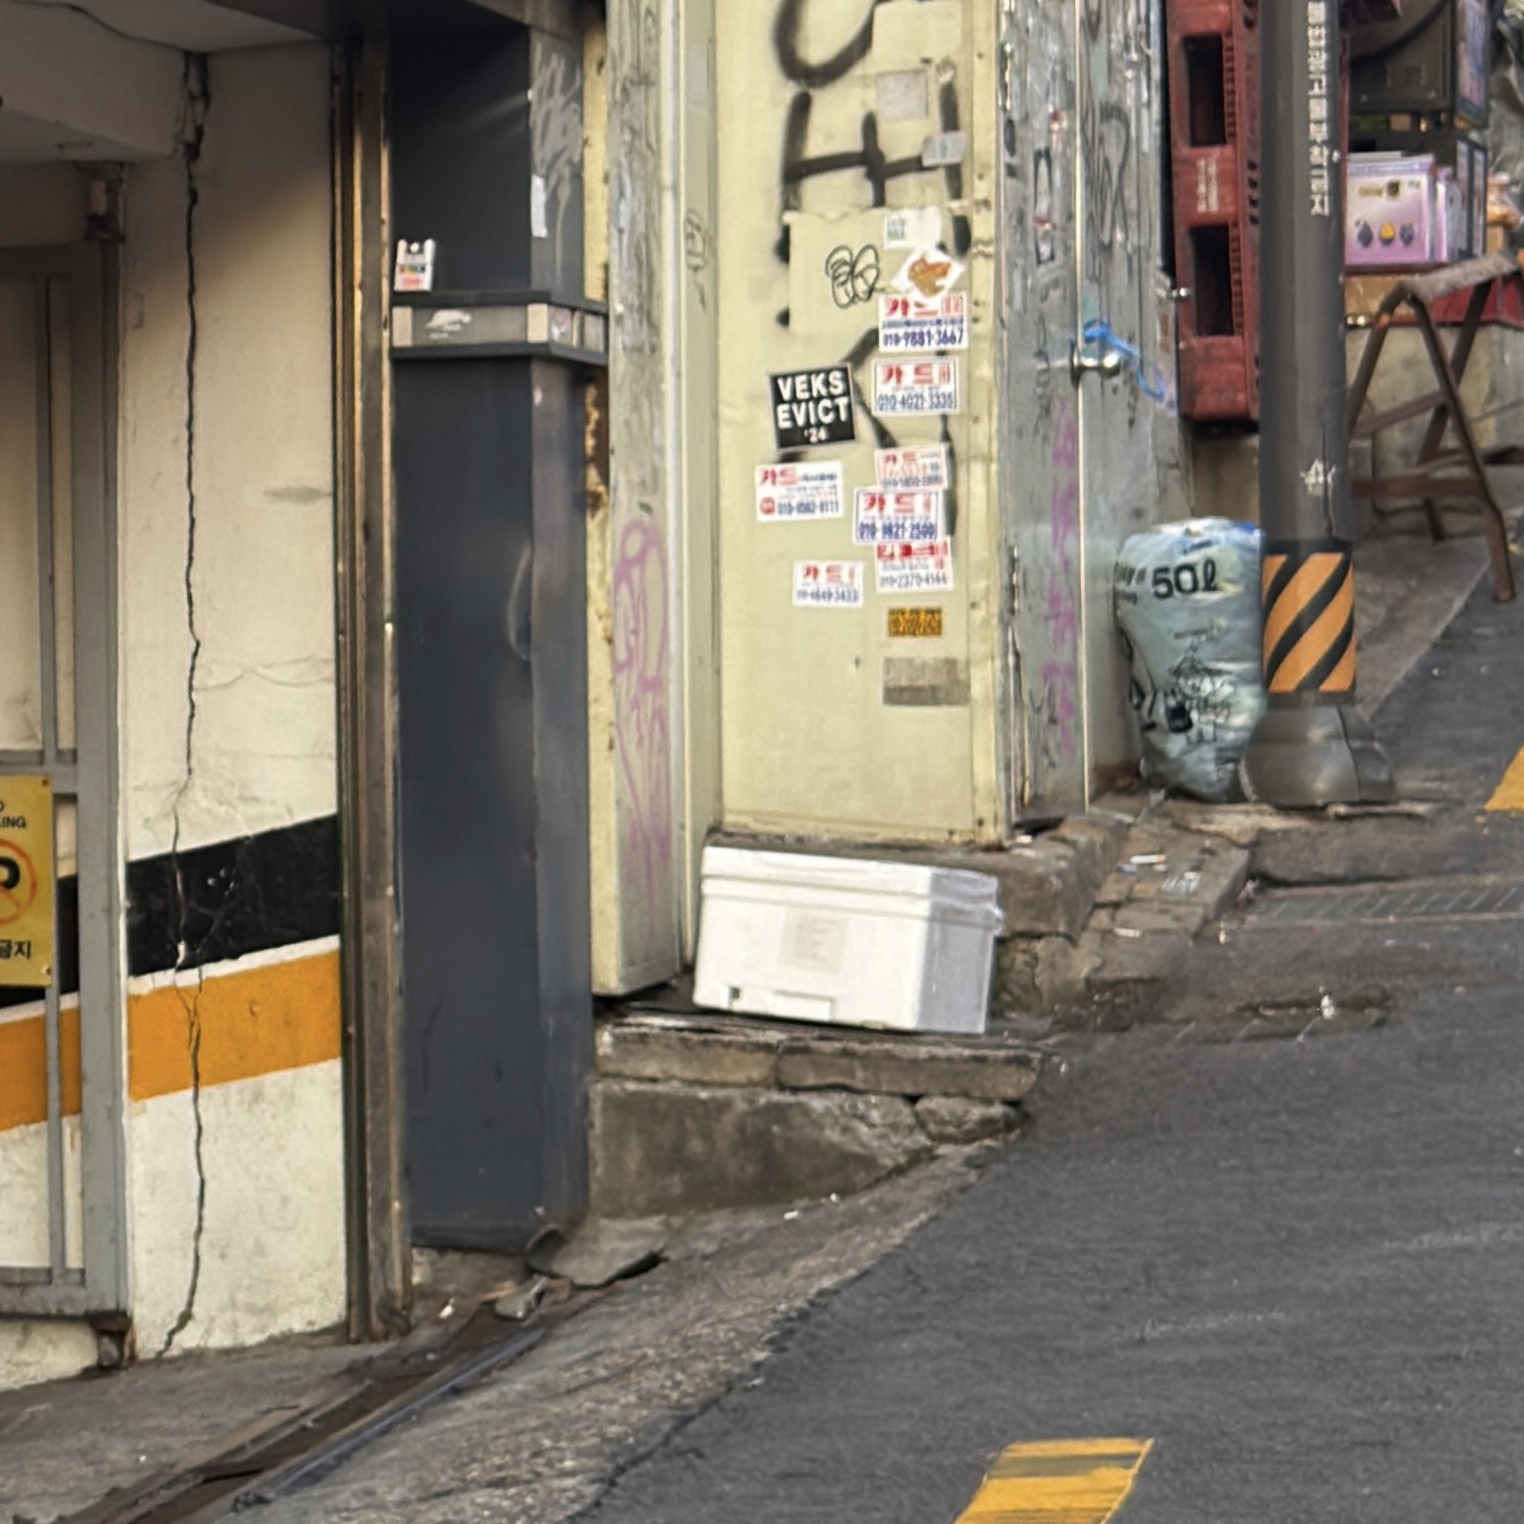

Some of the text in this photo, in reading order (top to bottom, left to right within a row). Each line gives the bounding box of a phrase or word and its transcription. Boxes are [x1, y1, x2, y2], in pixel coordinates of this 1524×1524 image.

[777, 370, 846, 402] VEKS
[882, 363, 934, 387] 카드
[776, 396, 849, 430] EVICT
[803, 427, 829, 443] '24
[759, 467, 798, 486] 카드
[862, 492, 915, 514] 카드
